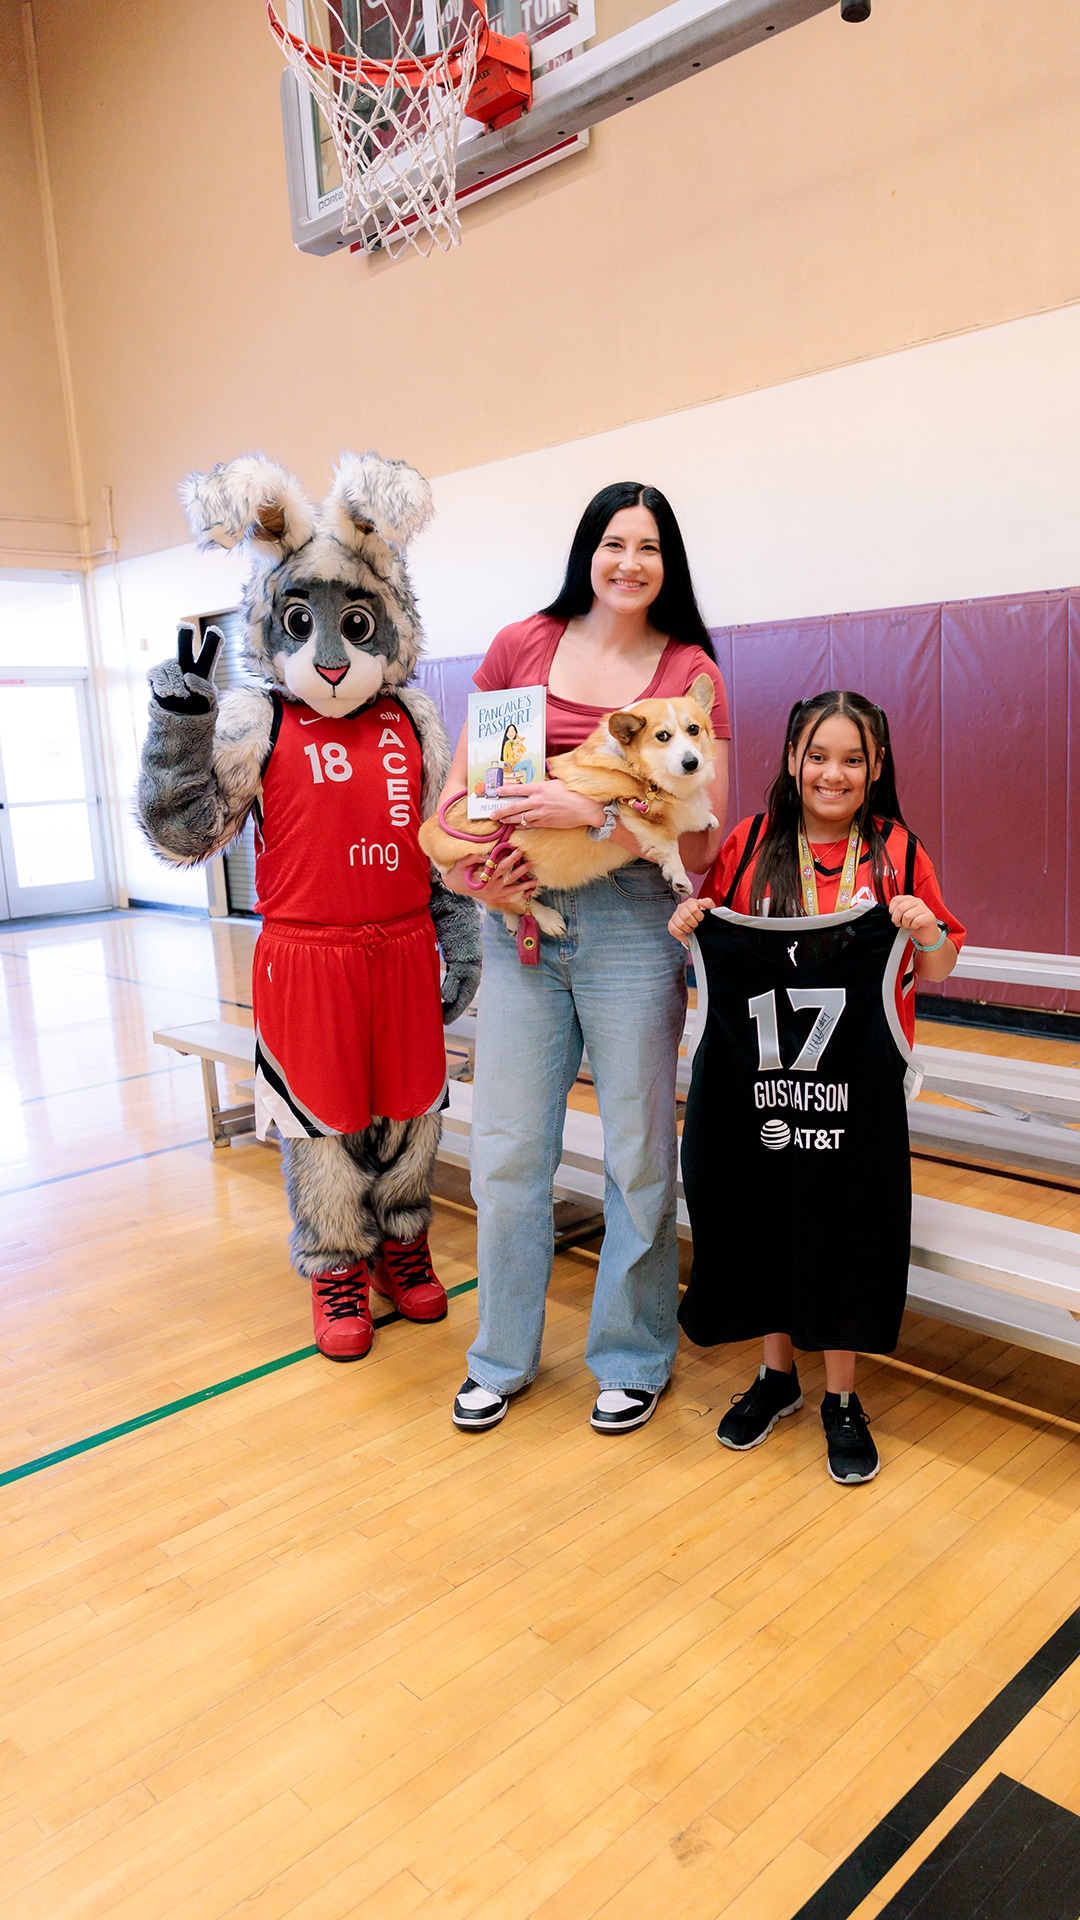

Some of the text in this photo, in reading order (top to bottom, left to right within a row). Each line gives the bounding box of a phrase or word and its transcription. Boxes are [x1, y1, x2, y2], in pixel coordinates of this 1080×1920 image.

[318, 190, 345, 212] porte
[380, 711, 400, 722] ally
[478, 694, 532, 724] PANCAKE'S
[478, 707, 532, 738] PASSPORT
[304, 742, 353, 784] 18
[378, 728, 411, 827] ACES
[349, 838, 399, 872] ring
[748, 987, 846, 1072] 17
[754, 1079, 848, 1112] GUSTAFSON
[794, 1127, 845, 1150] AT&T
